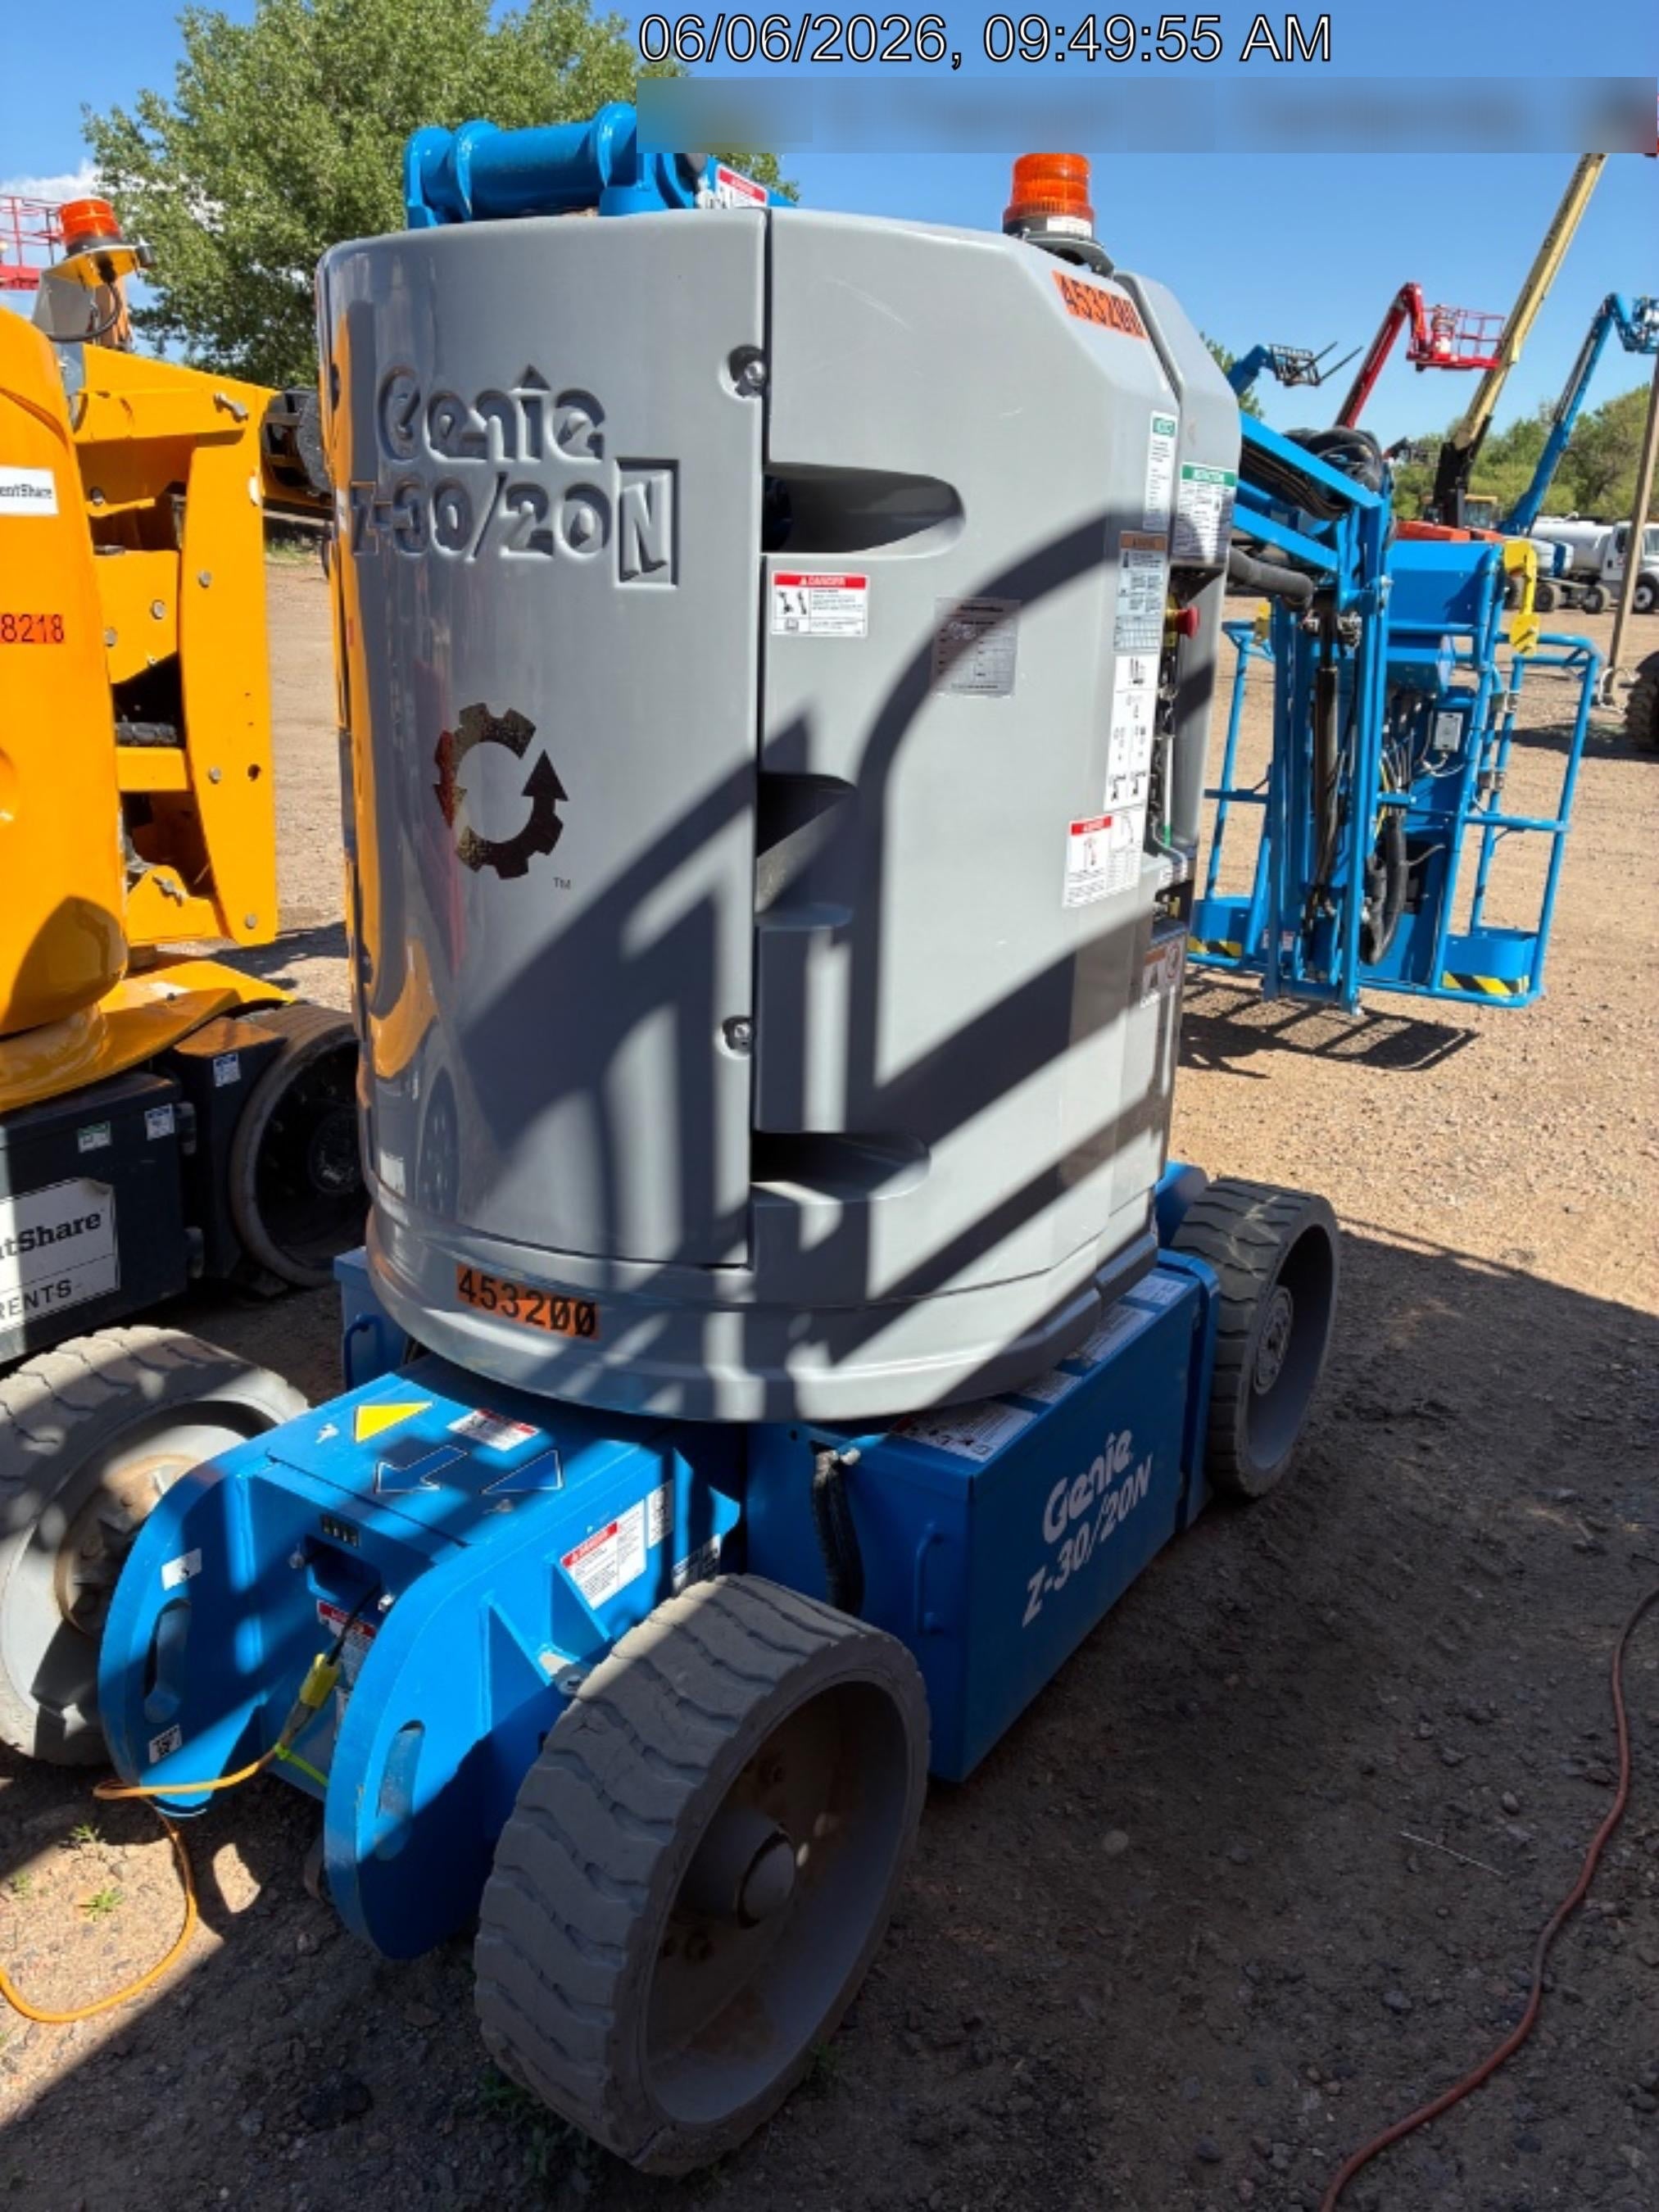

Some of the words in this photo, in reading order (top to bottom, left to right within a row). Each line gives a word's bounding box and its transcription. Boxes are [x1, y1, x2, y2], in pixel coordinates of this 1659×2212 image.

[378, 364, 605, 464] Genie
[1, 614, 64, 643] 8218
[459, 1270, 596, 1337] 453200
[1043, 1430, 1134, 1544] Genie
